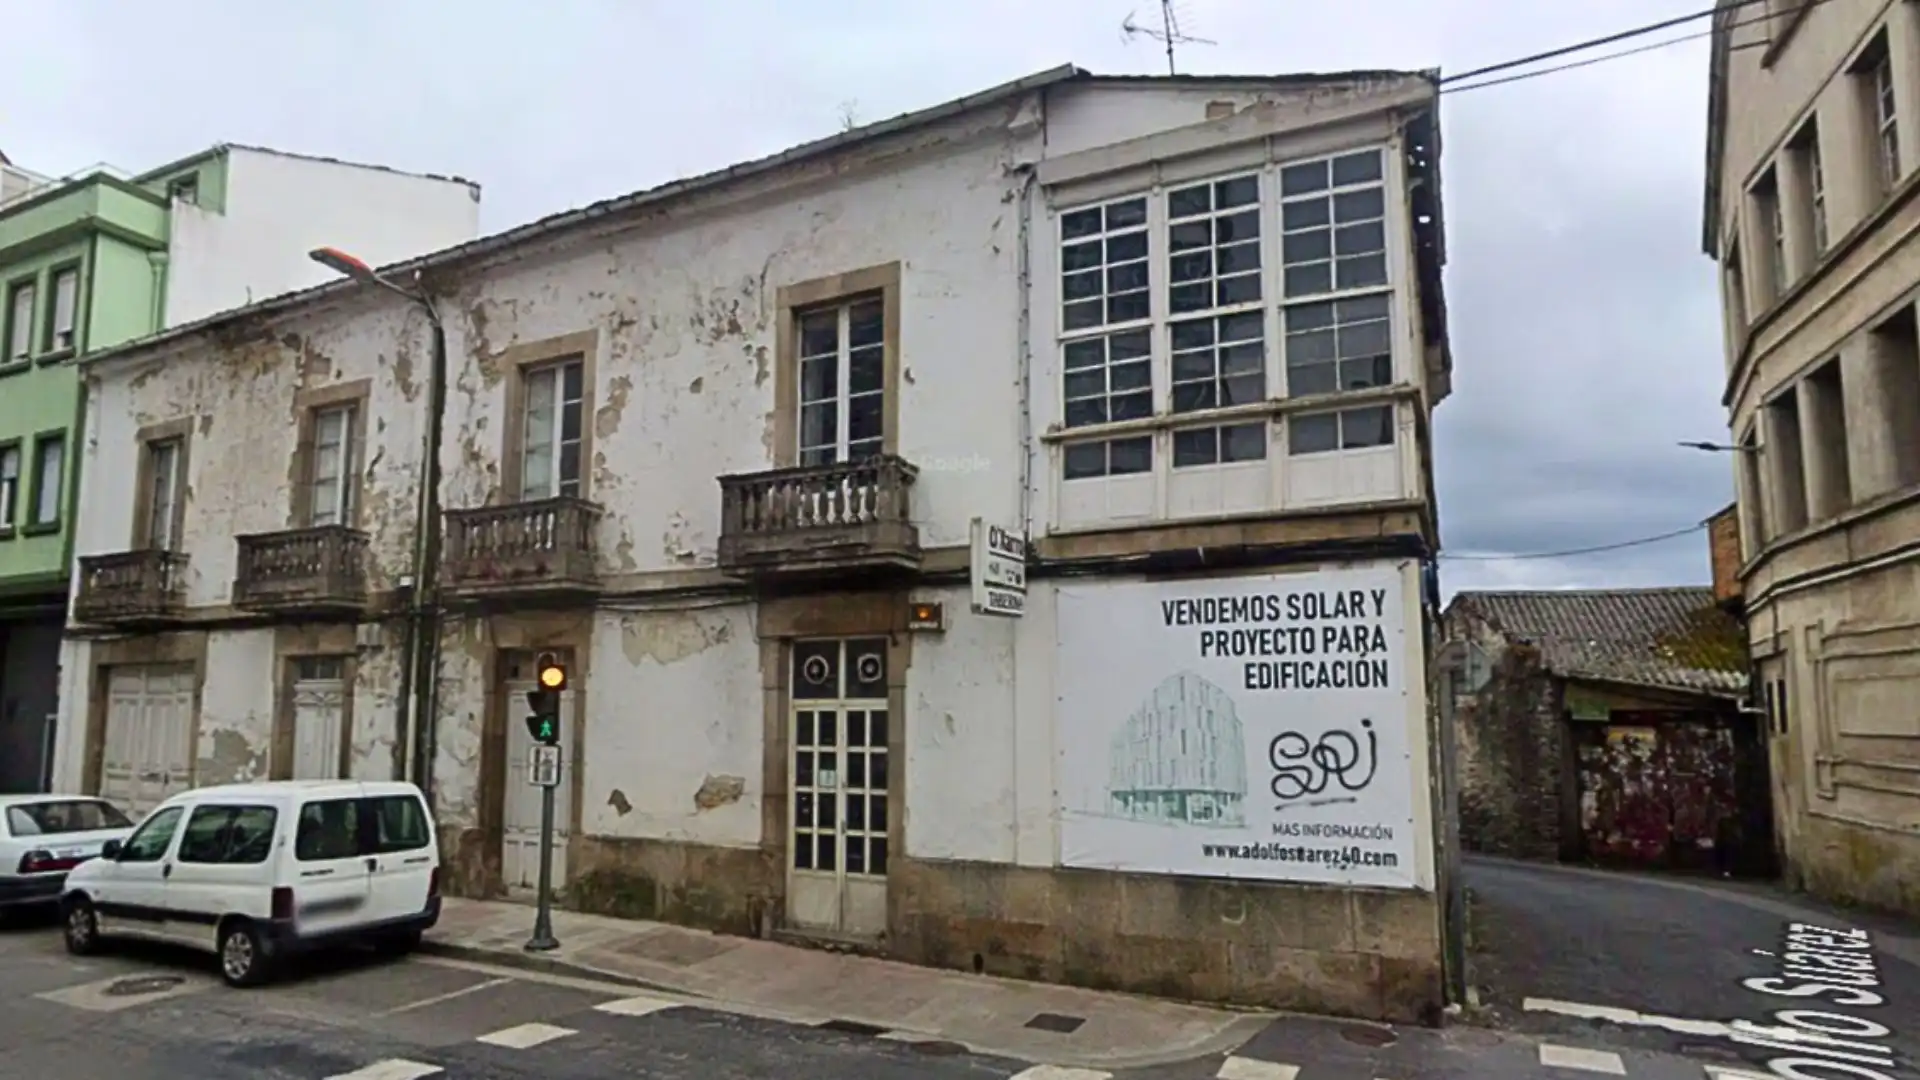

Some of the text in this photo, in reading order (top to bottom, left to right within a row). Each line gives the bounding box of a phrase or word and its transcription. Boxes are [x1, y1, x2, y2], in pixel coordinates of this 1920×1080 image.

[1162, 589, 1386, 626] VENDEMOS SOLAR Y
[1201, 624, 1388, 657] PROYECTO PARA
[1245, 653, 1388, 689] EDIFICACIÓN
[1301, 821, 1393, 841] INFORMACIÓN
[1202, 841, 1398, 868] www.adolfosuarez40.com
